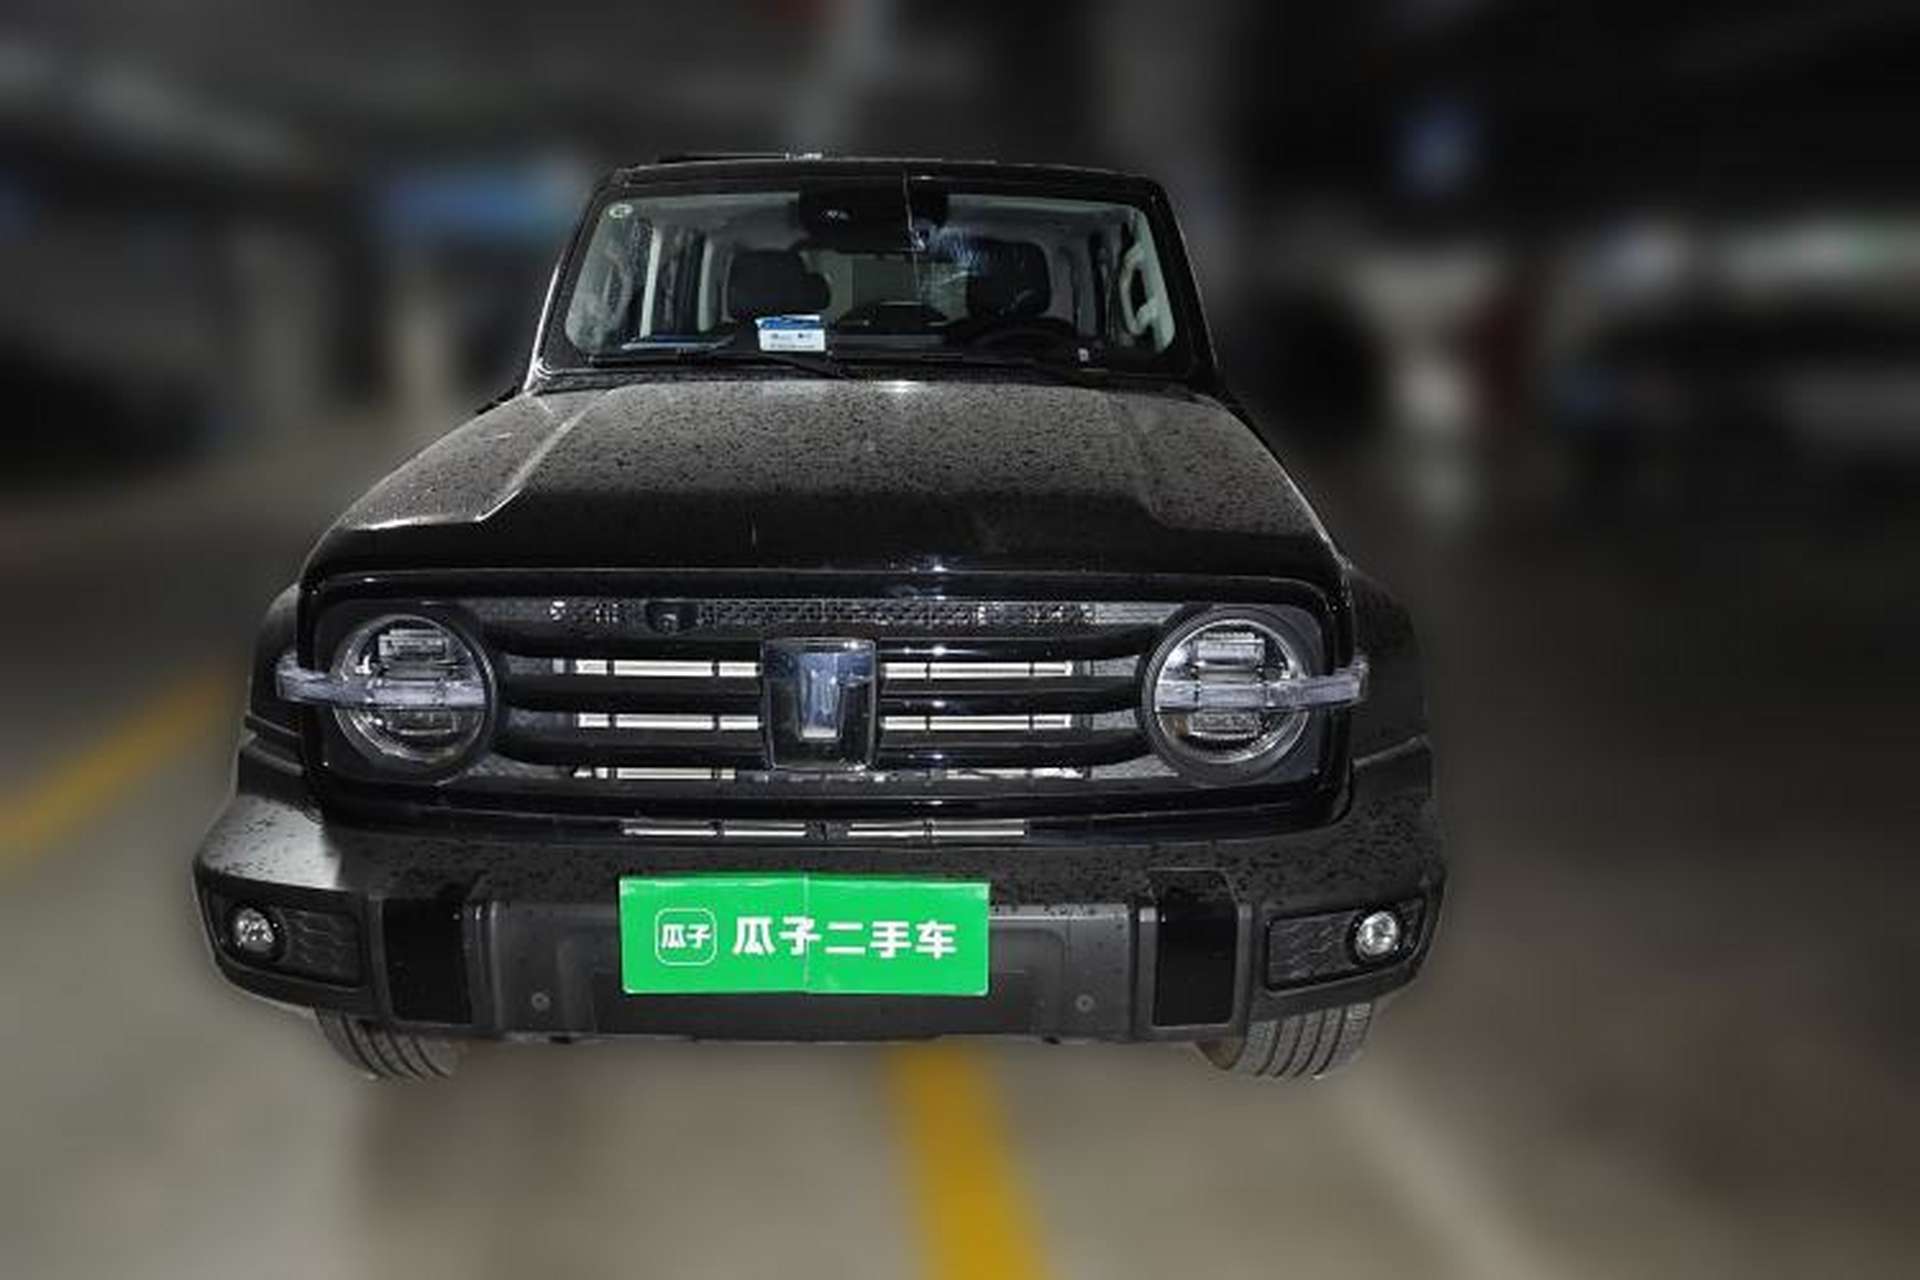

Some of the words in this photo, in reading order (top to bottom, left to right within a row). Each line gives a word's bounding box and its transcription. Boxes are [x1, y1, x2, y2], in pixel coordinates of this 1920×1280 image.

[661, 923, 712, 949] 瓜子
[732, 916, 957, 959] 瓜子二手车
